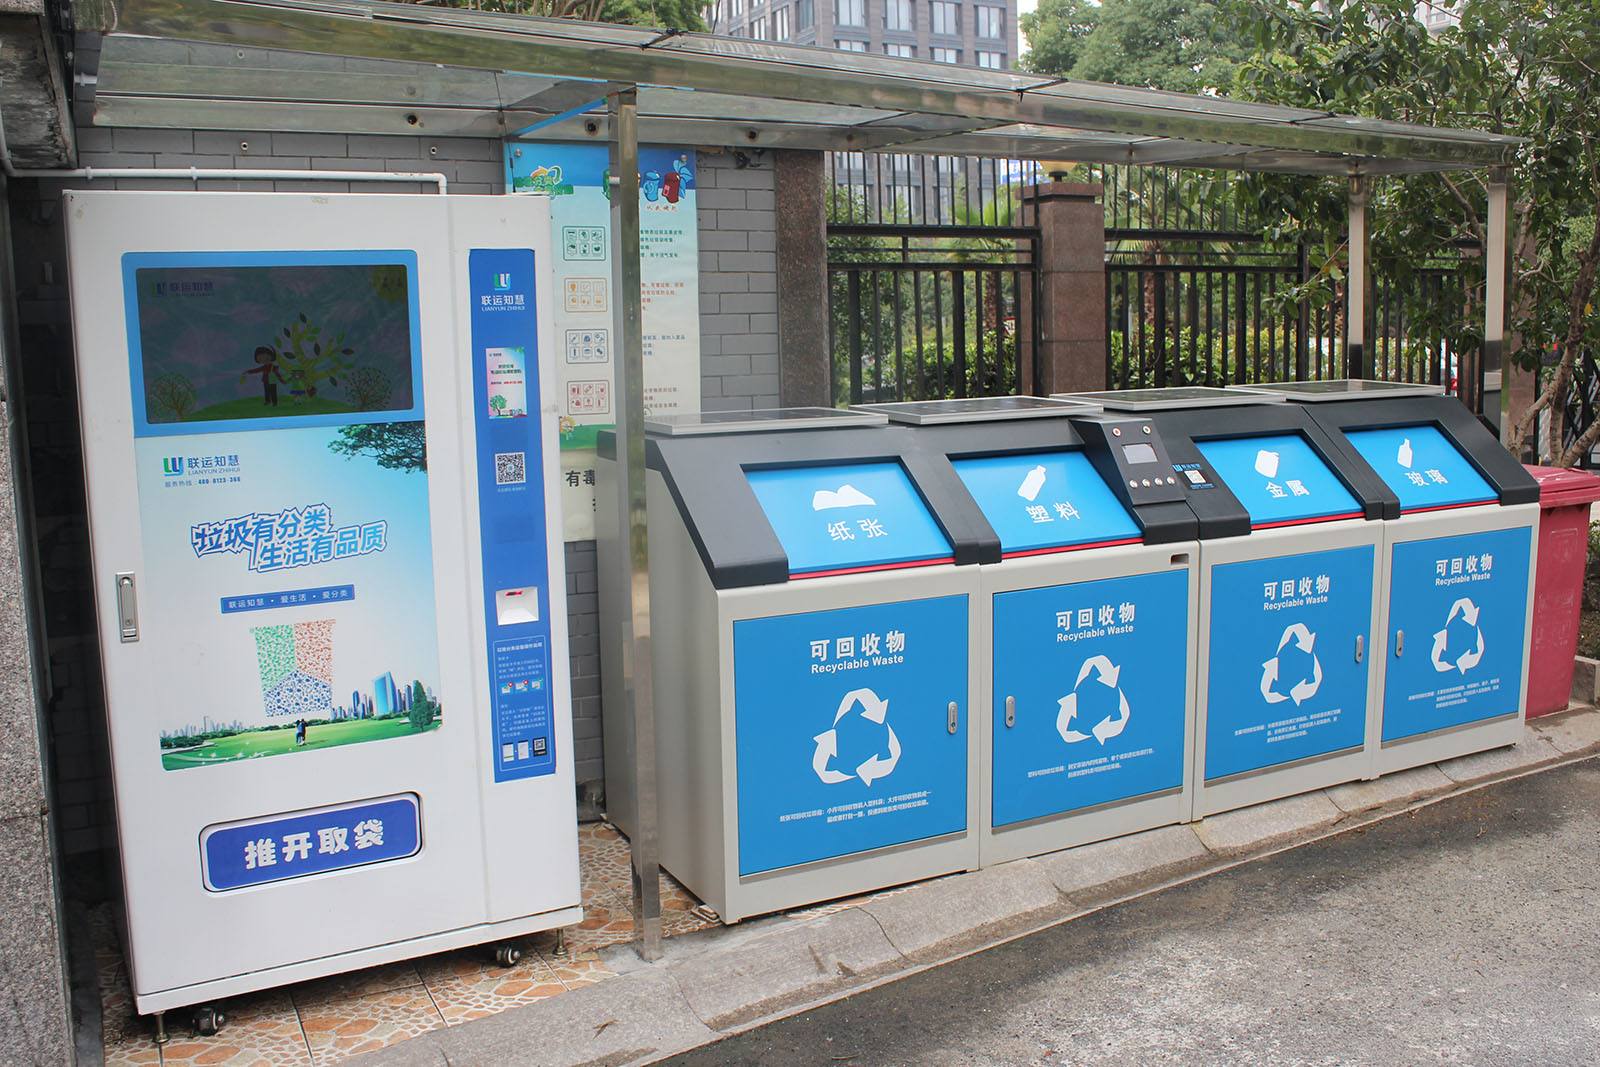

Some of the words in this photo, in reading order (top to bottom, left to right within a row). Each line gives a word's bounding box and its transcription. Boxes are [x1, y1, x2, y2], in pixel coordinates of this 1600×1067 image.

[481, 294, 525, 306] 联运知慧
[187, 454, 240, 469] 联运知慧
[1265, 479, 1310, 498] 金属
[1404, 468, 1449, 487] 玻璃
[1025, 501, 1081, 524] 塑料
[192, 504, 329, 554] 垃圾有分类
[827, 518, 888, 541] 纸张
[258, 522, 387, 570] 生活有品质
[1435, 553, 1493, 577] 可回收物
[1263, 574, 1330, 601] 可回收物
[1435, 574, 1470, 587] Recyclable
[1471, 572, 1491, 582] Waste
[1263, 598, 1304, 611] Recyclable
[1305, 594, 1328, 605] Waste
[1056, 601, 1136, 631] 可回收物
[1056, 628, 1105, 643] Recyclable
[1107, 623, 1134, 636] Waste
[809, 629, 905, 662] 可回收物
[811, 658, 870, 675] Recyclable
[872, 654, 905, 668] Waste
[244, 818, 385, 870] 推开取袋
